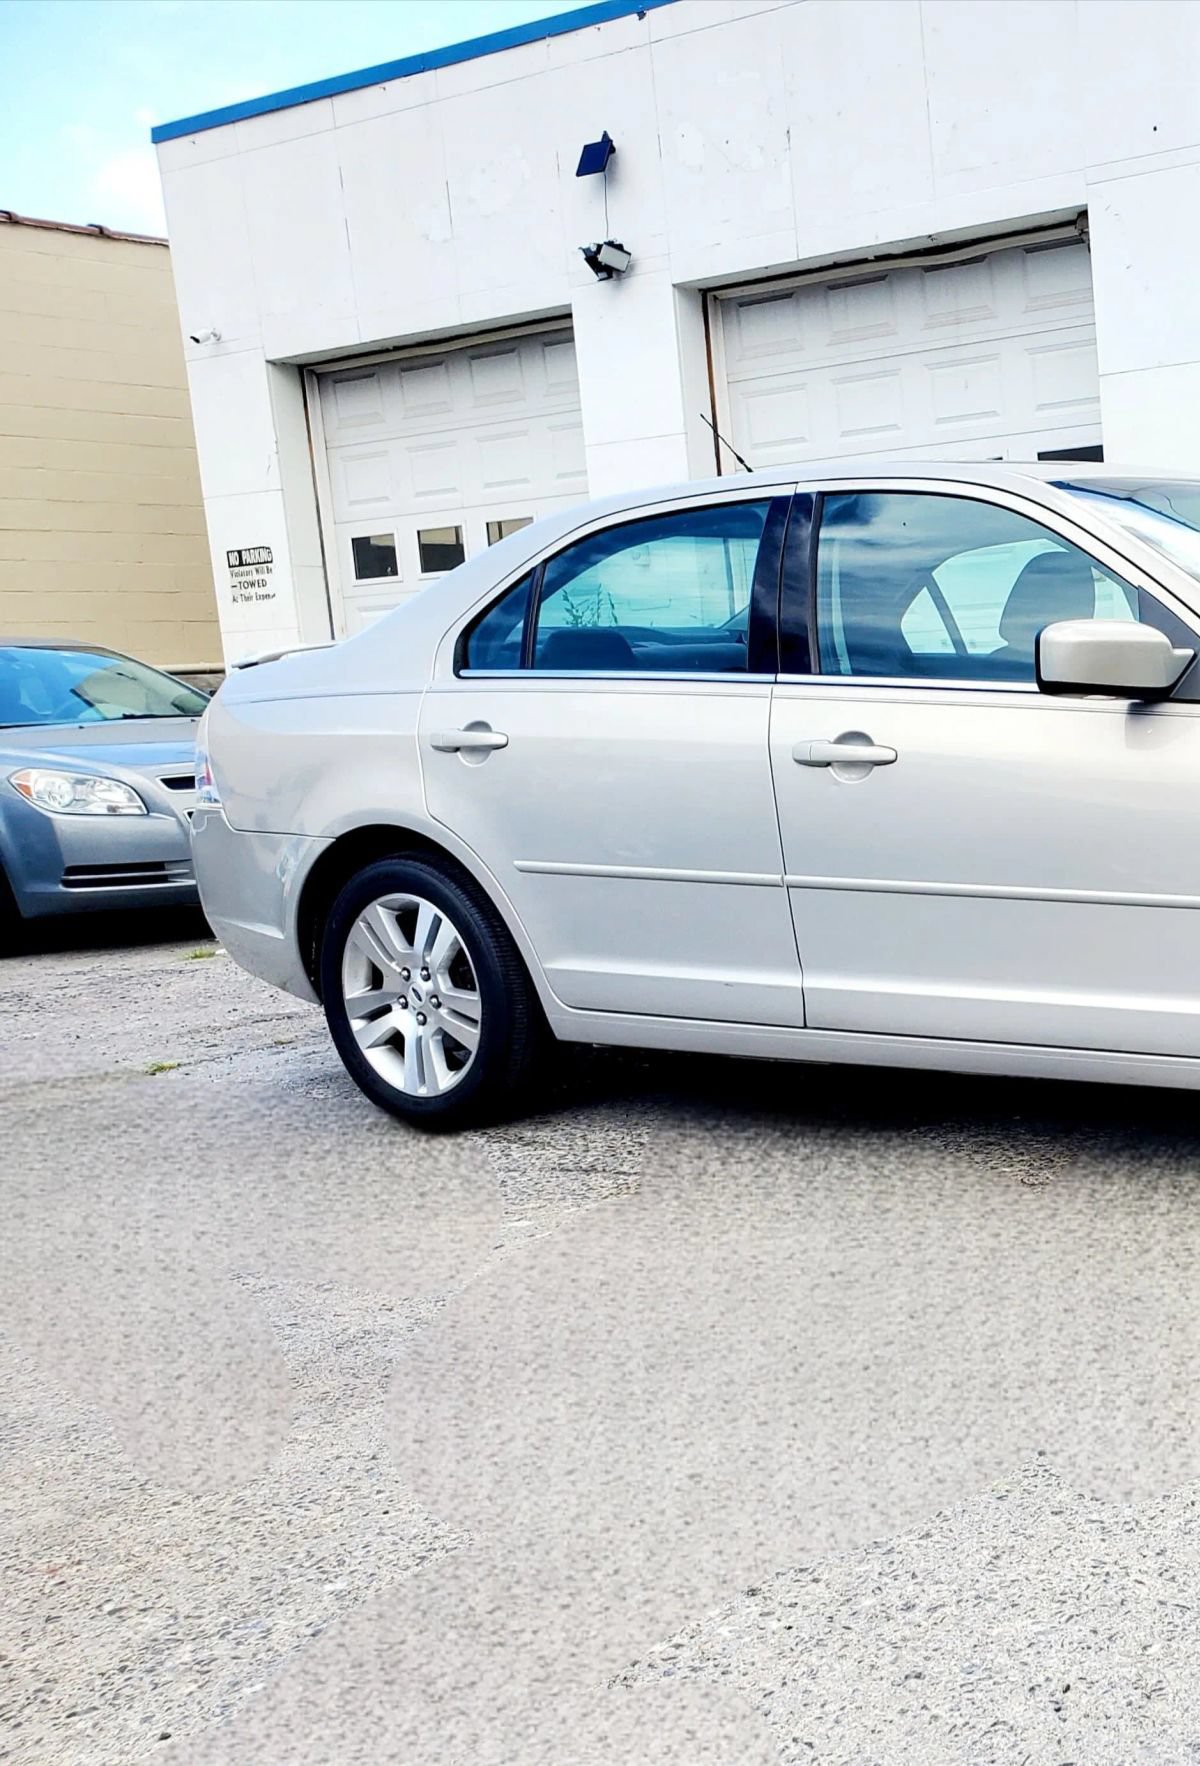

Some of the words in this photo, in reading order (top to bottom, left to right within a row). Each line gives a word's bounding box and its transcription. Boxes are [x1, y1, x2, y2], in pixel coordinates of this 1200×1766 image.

[228, 551, 240, 566] NO
[241, 548, 272, 565] PARKING
[238, 579, 267, 590] TOWED
